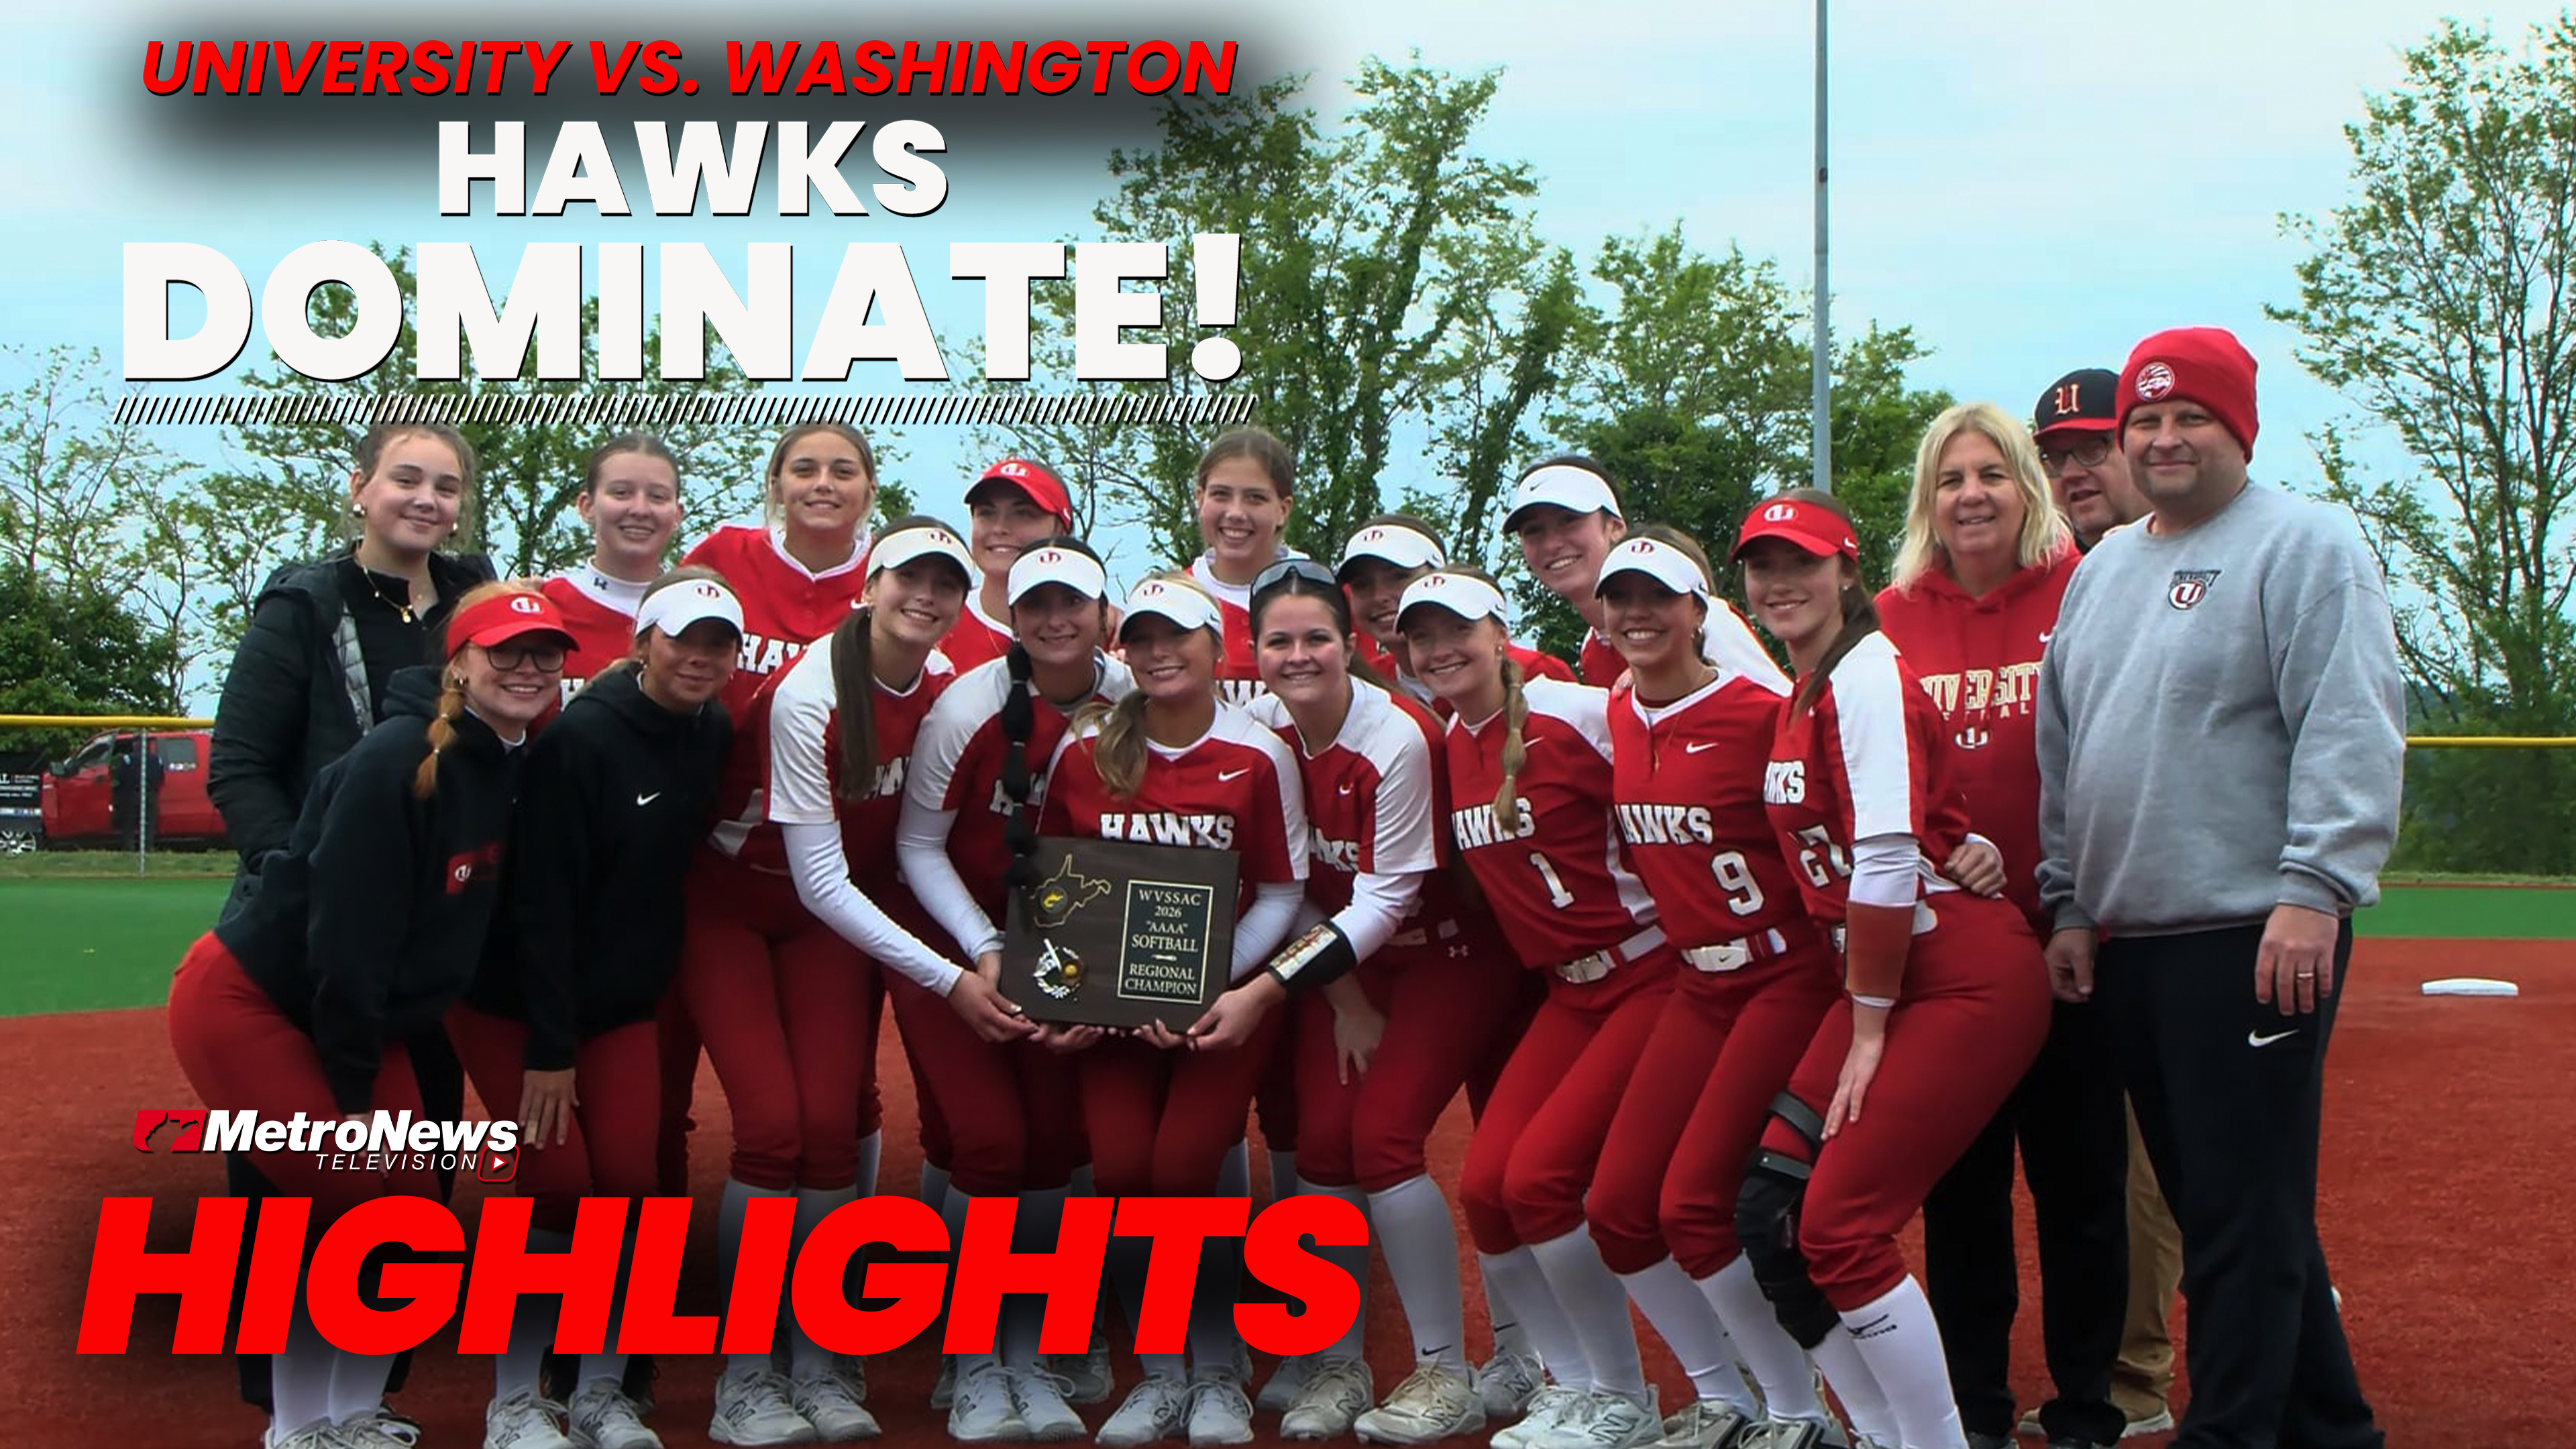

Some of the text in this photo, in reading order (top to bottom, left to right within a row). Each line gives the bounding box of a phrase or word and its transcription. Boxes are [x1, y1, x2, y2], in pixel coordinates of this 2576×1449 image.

[1100, 812, 1234, 850] HAWKS
[1529, 852, 1574, 909] 1
[1711, 851, 1764, 916] 9
[1139, 889, 1201, 906] WVSSAC
[1155, 906, 1182, 918] 2026
[1131, 934, 1198, 952] SOFTBALL
[1129, 963, 1195, 980] REGIONAL
[1124, 978, 1197, 995] CHAMPION
